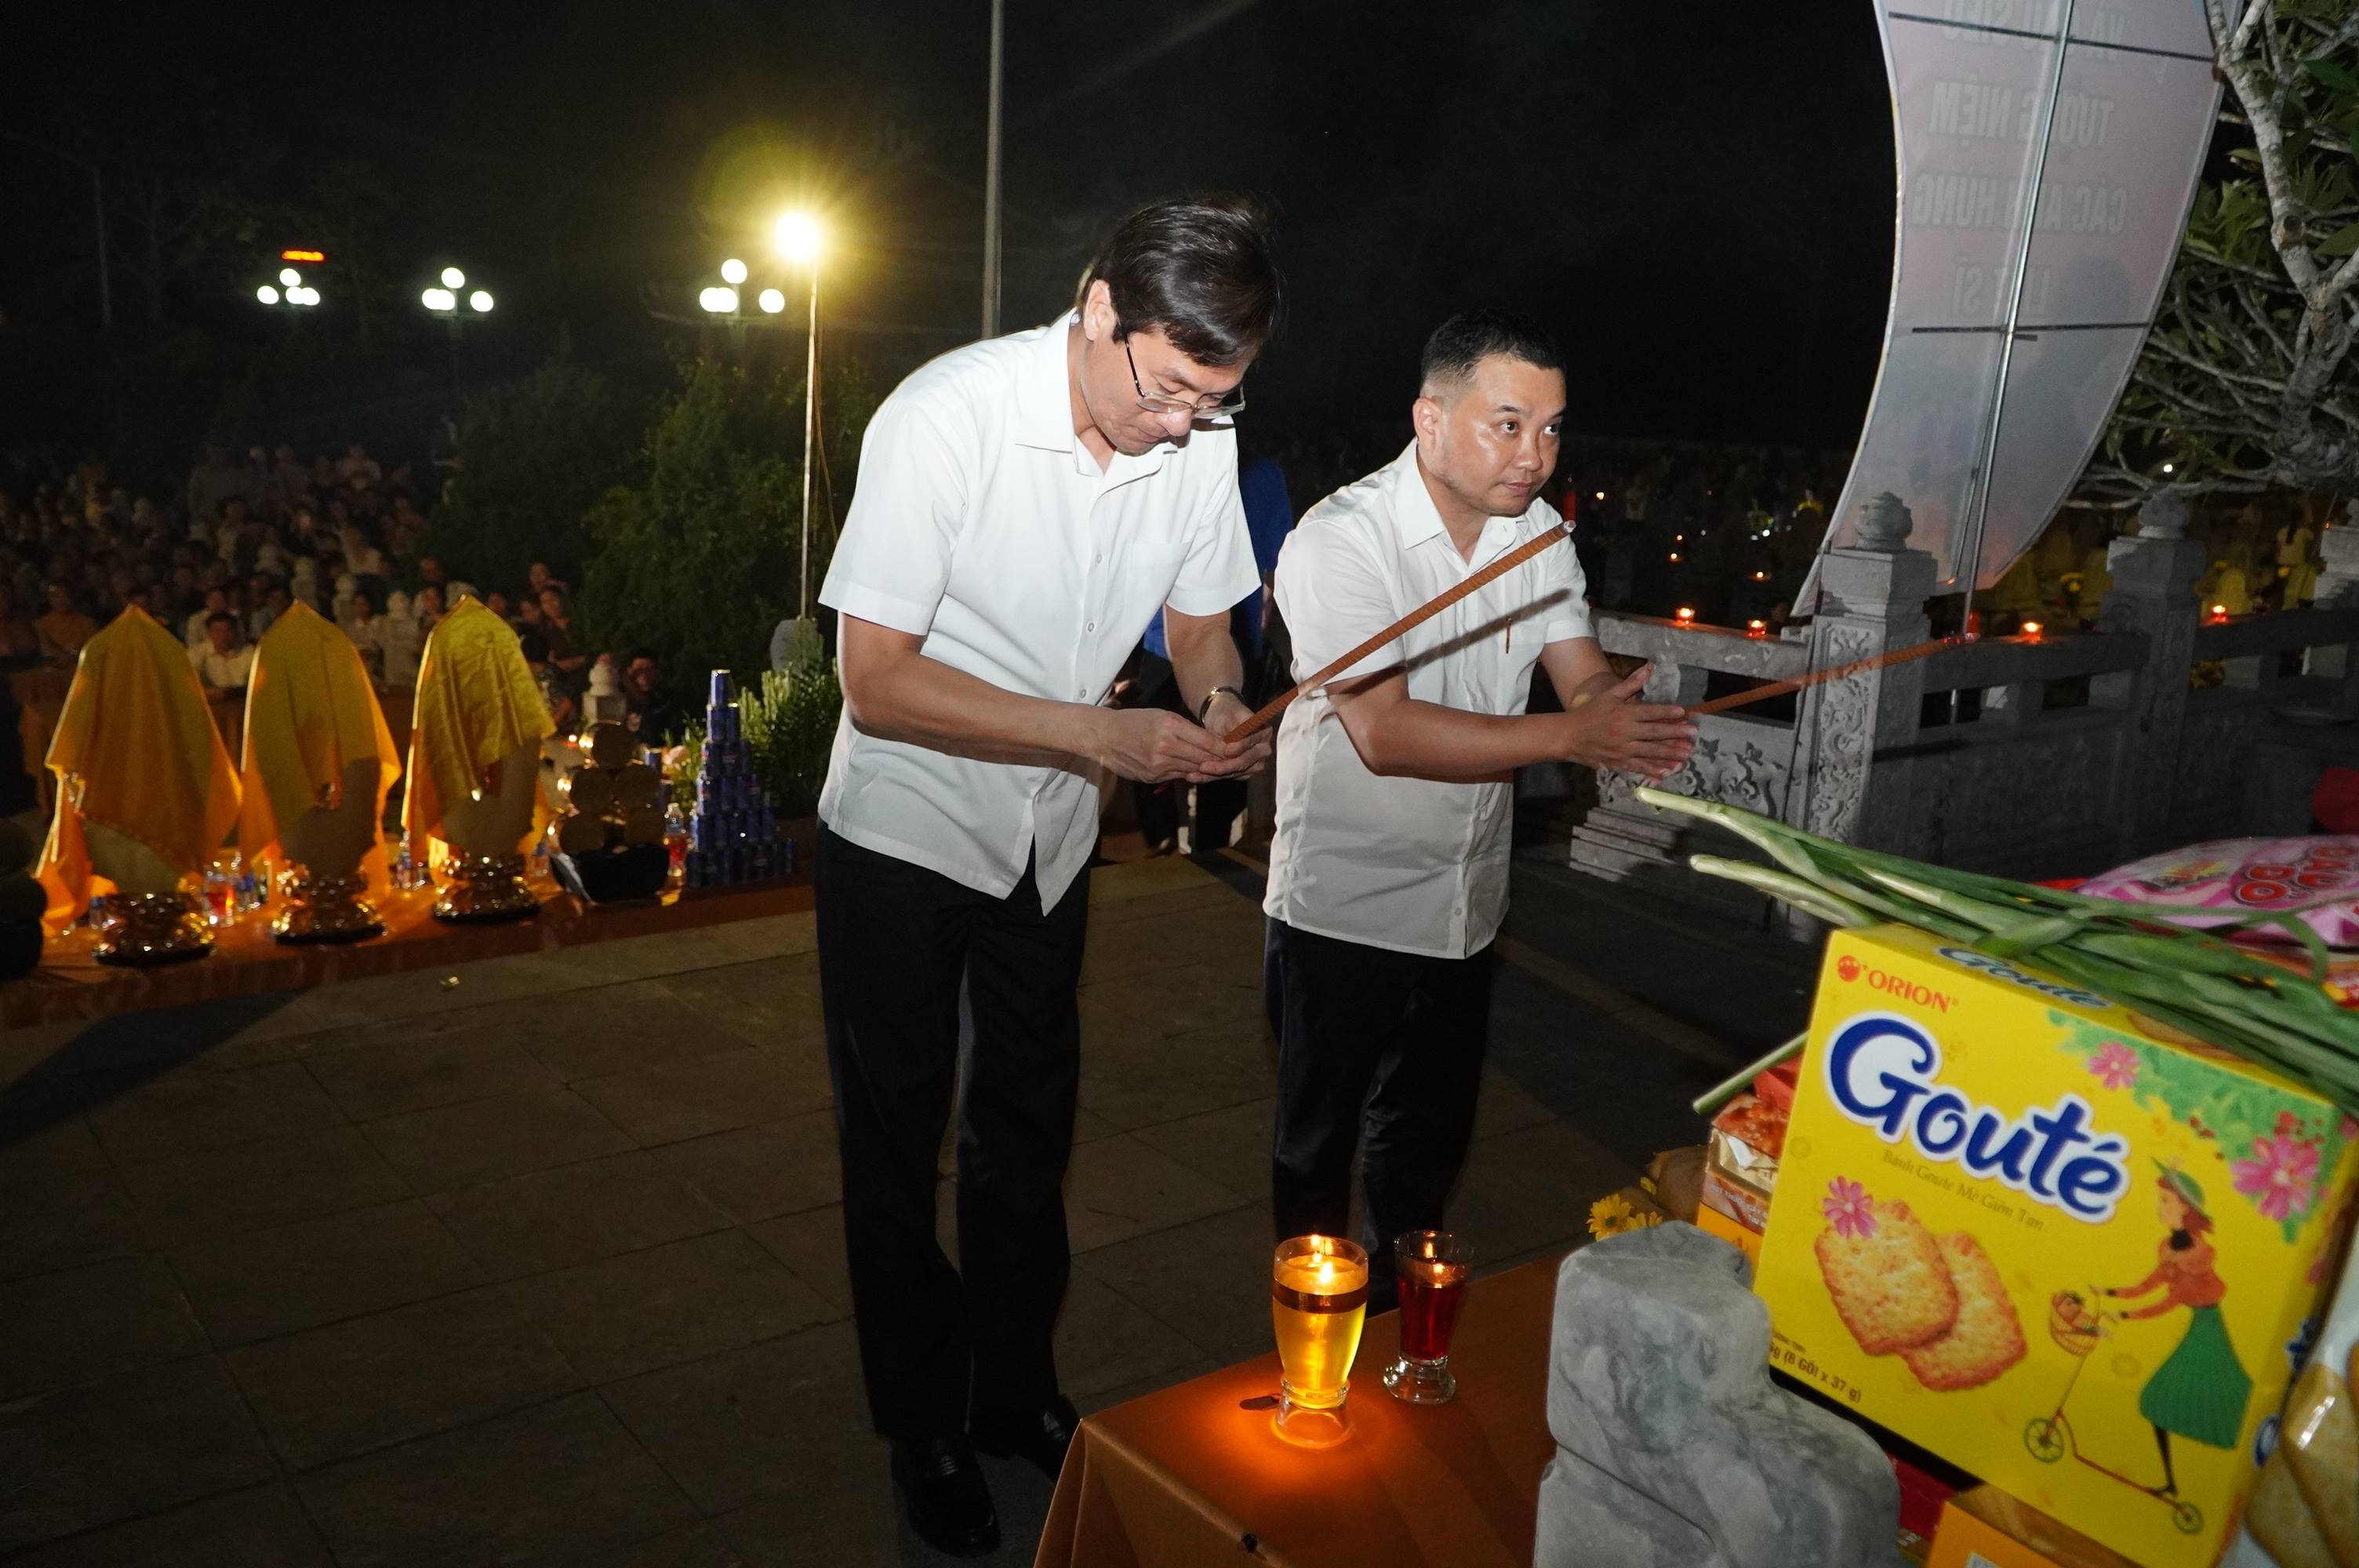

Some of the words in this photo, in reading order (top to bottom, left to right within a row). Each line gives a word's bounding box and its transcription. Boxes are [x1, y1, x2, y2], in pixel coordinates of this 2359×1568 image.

[1868, 970, 1951, 1014] ORION
[1826, 1014, 2126, 1218] Gouté
[1831, 1376, 1847, 1392] 37
